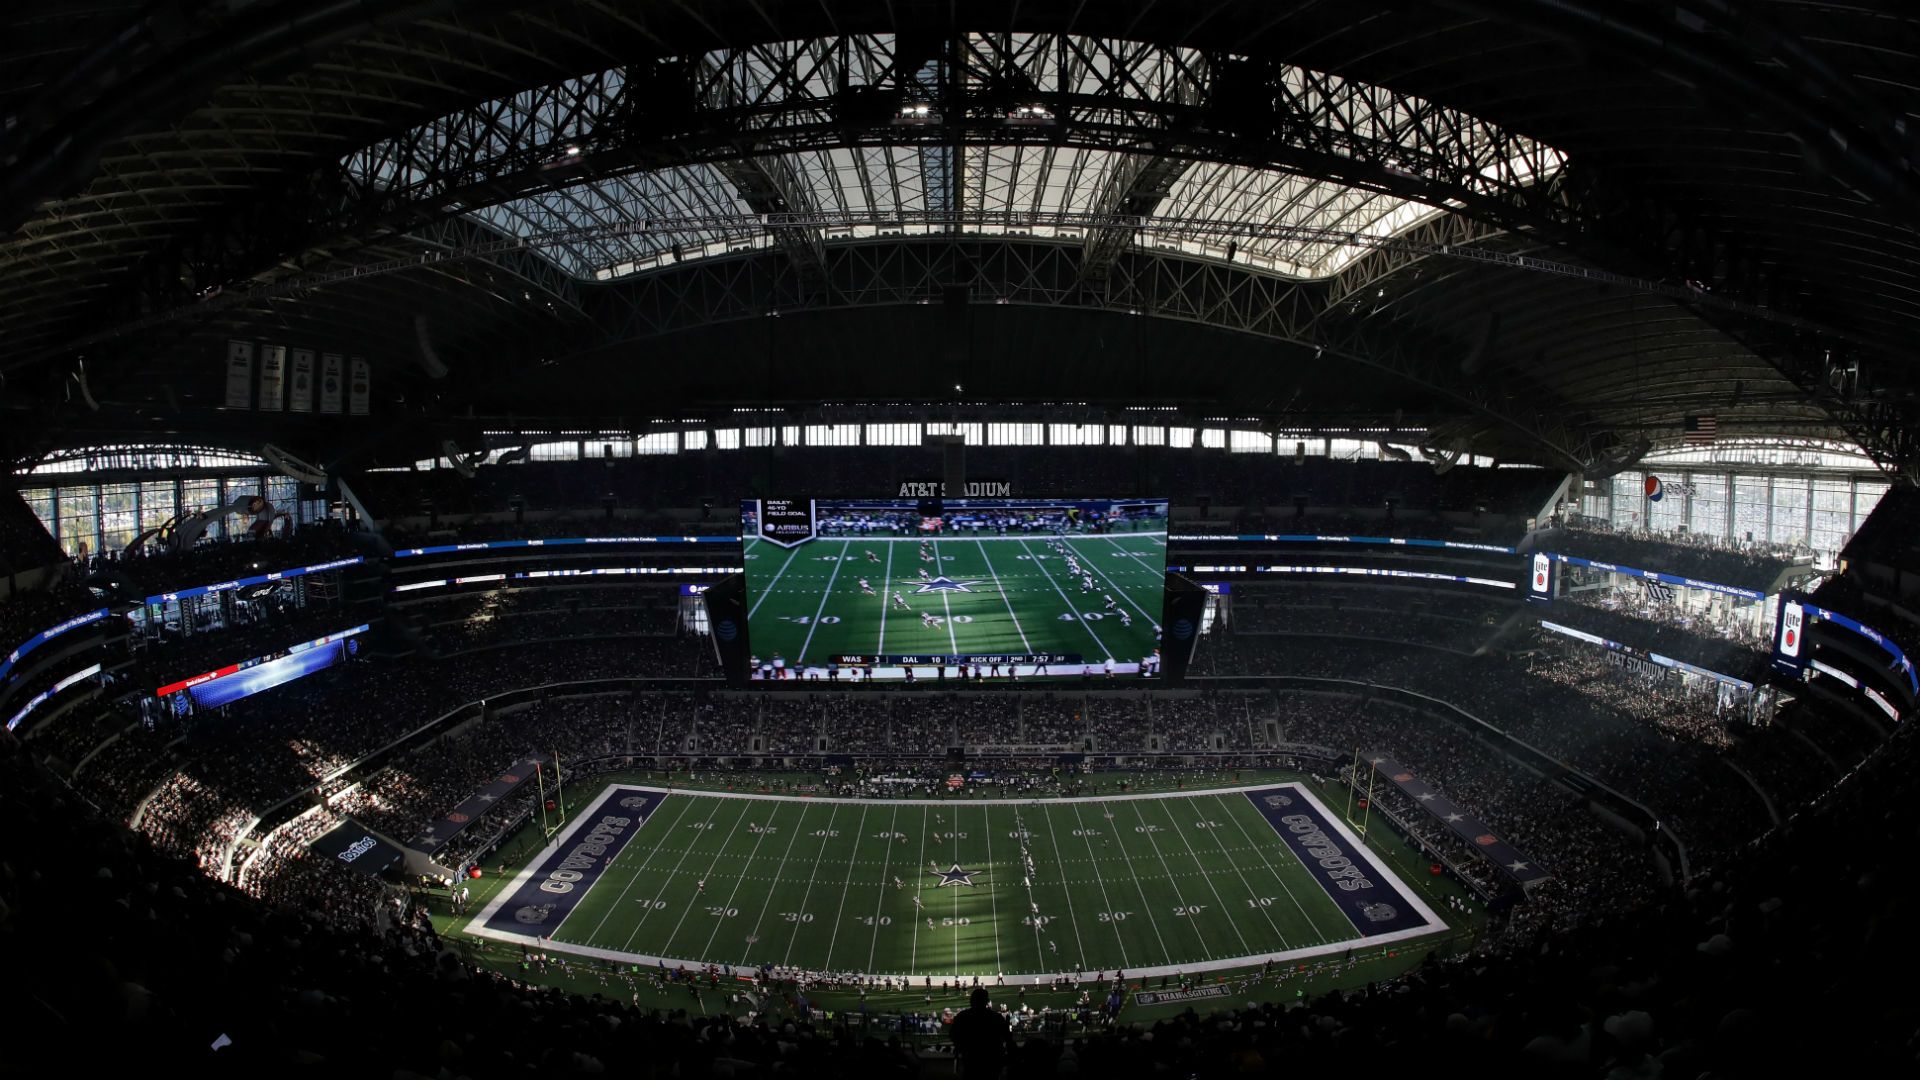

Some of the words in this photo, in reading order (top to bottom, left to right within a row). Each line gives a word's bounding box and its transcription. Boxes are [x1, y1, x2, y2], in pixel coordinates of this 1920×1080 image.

[899, 482, 938, 497] AT&T
[1535, 561, 1548, 573] Lite
[1785, 612, 1801, 628] Lite
[1626, 656, 1666, 681] STADIUM
[540, 815, 631, 894] COWBOYS
[1281, 814, 1374, 891] COWBOYS
[641, 899, 667, 910] 10
[1247, 897, 1272, 909] 10
[710, 906, 739, 917] 20
[1172, 905, 1201, 916] 20
[785, 912, 814, 923] 30
[863, 915, 892, 926] 40
[942, 917, 971, 927] 50
[1098, 911, 1126, 922] 30
